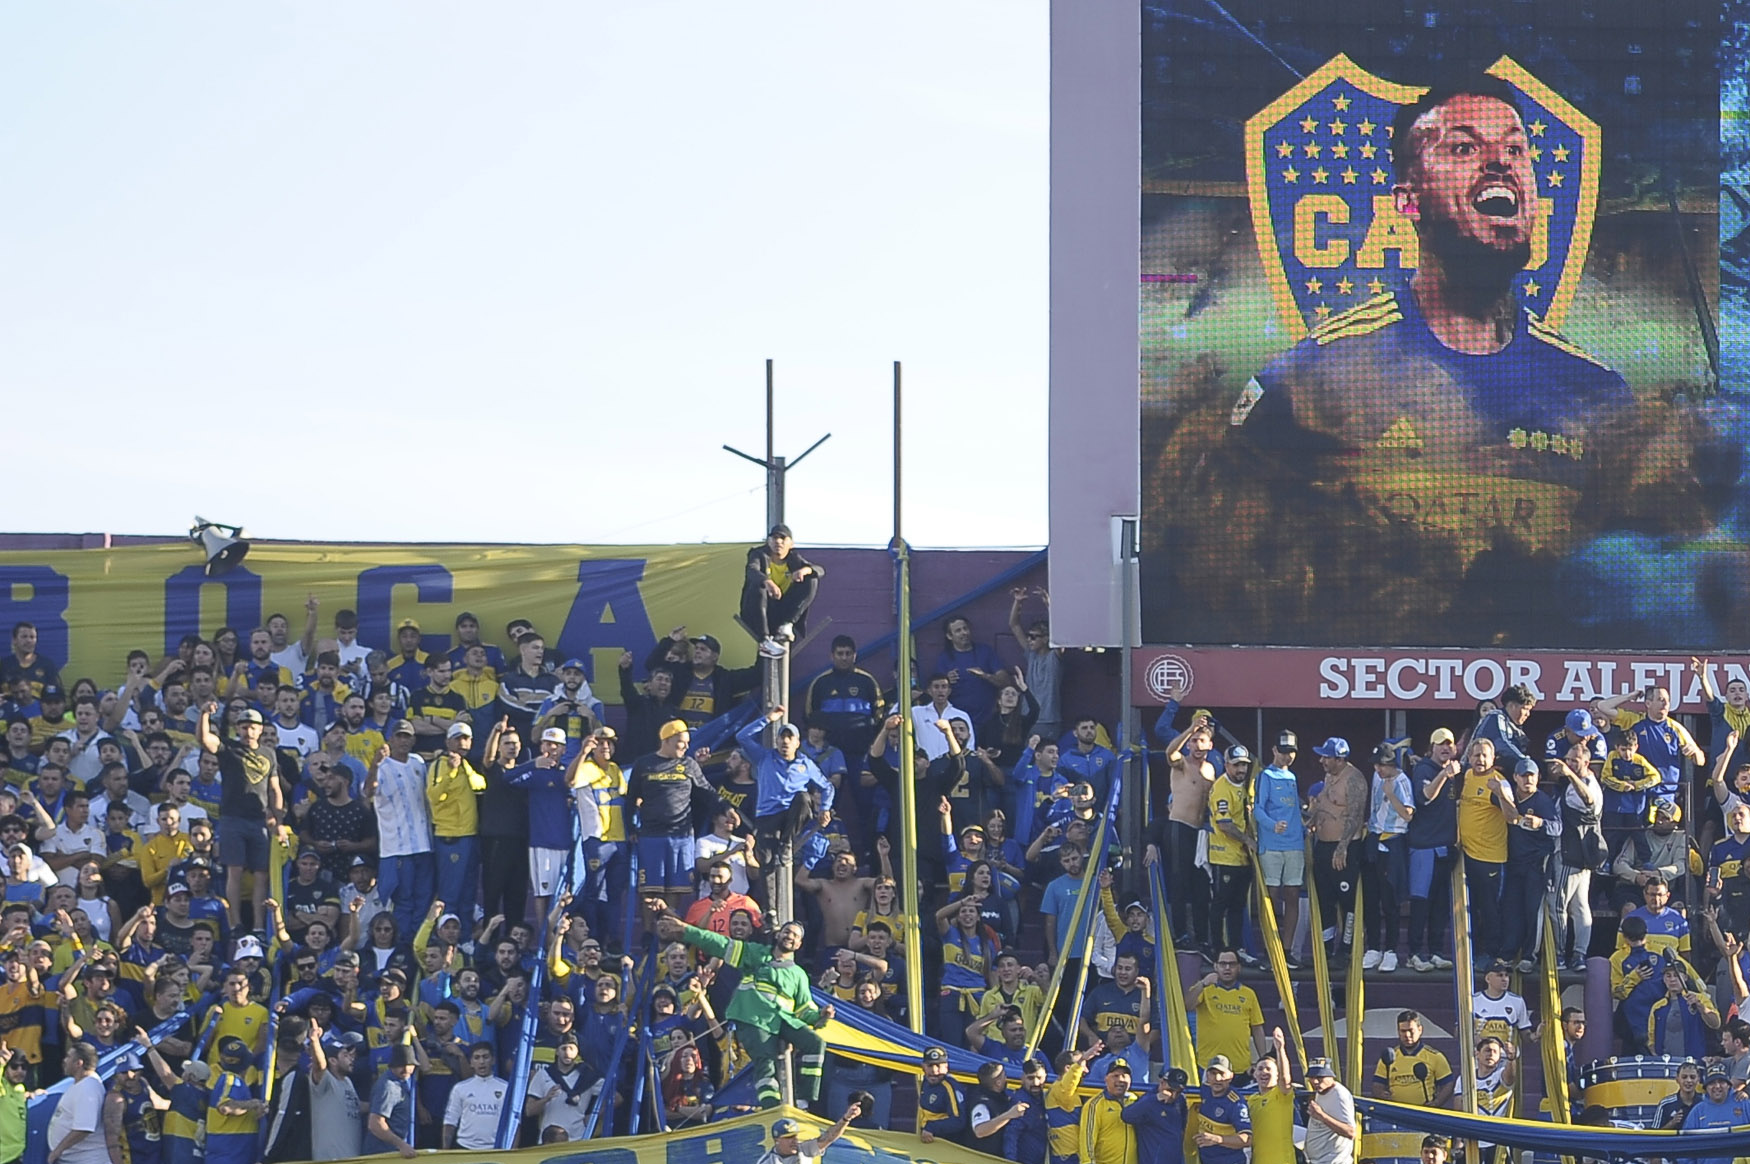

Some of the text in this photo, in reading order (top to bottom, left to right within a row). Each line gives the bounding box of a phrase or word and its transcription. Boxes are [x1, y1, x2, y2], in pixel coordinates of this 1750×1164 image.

[1295, 194, 1554, 270] CAJ
[0, 558, 672, 684] BOCA
[1319, 657, 1544, 701] SECTOR
[691, 698, 703, 708] 12
[713, 919, 725, 933] 12
[1216, 1003, 1241, 1012] QATAR
[1106, 1016, 1137, 1029] BBVA
[1483, 1022, 1508, 1031] QATAR
[469, 1104, 498, 1112] QATAR
